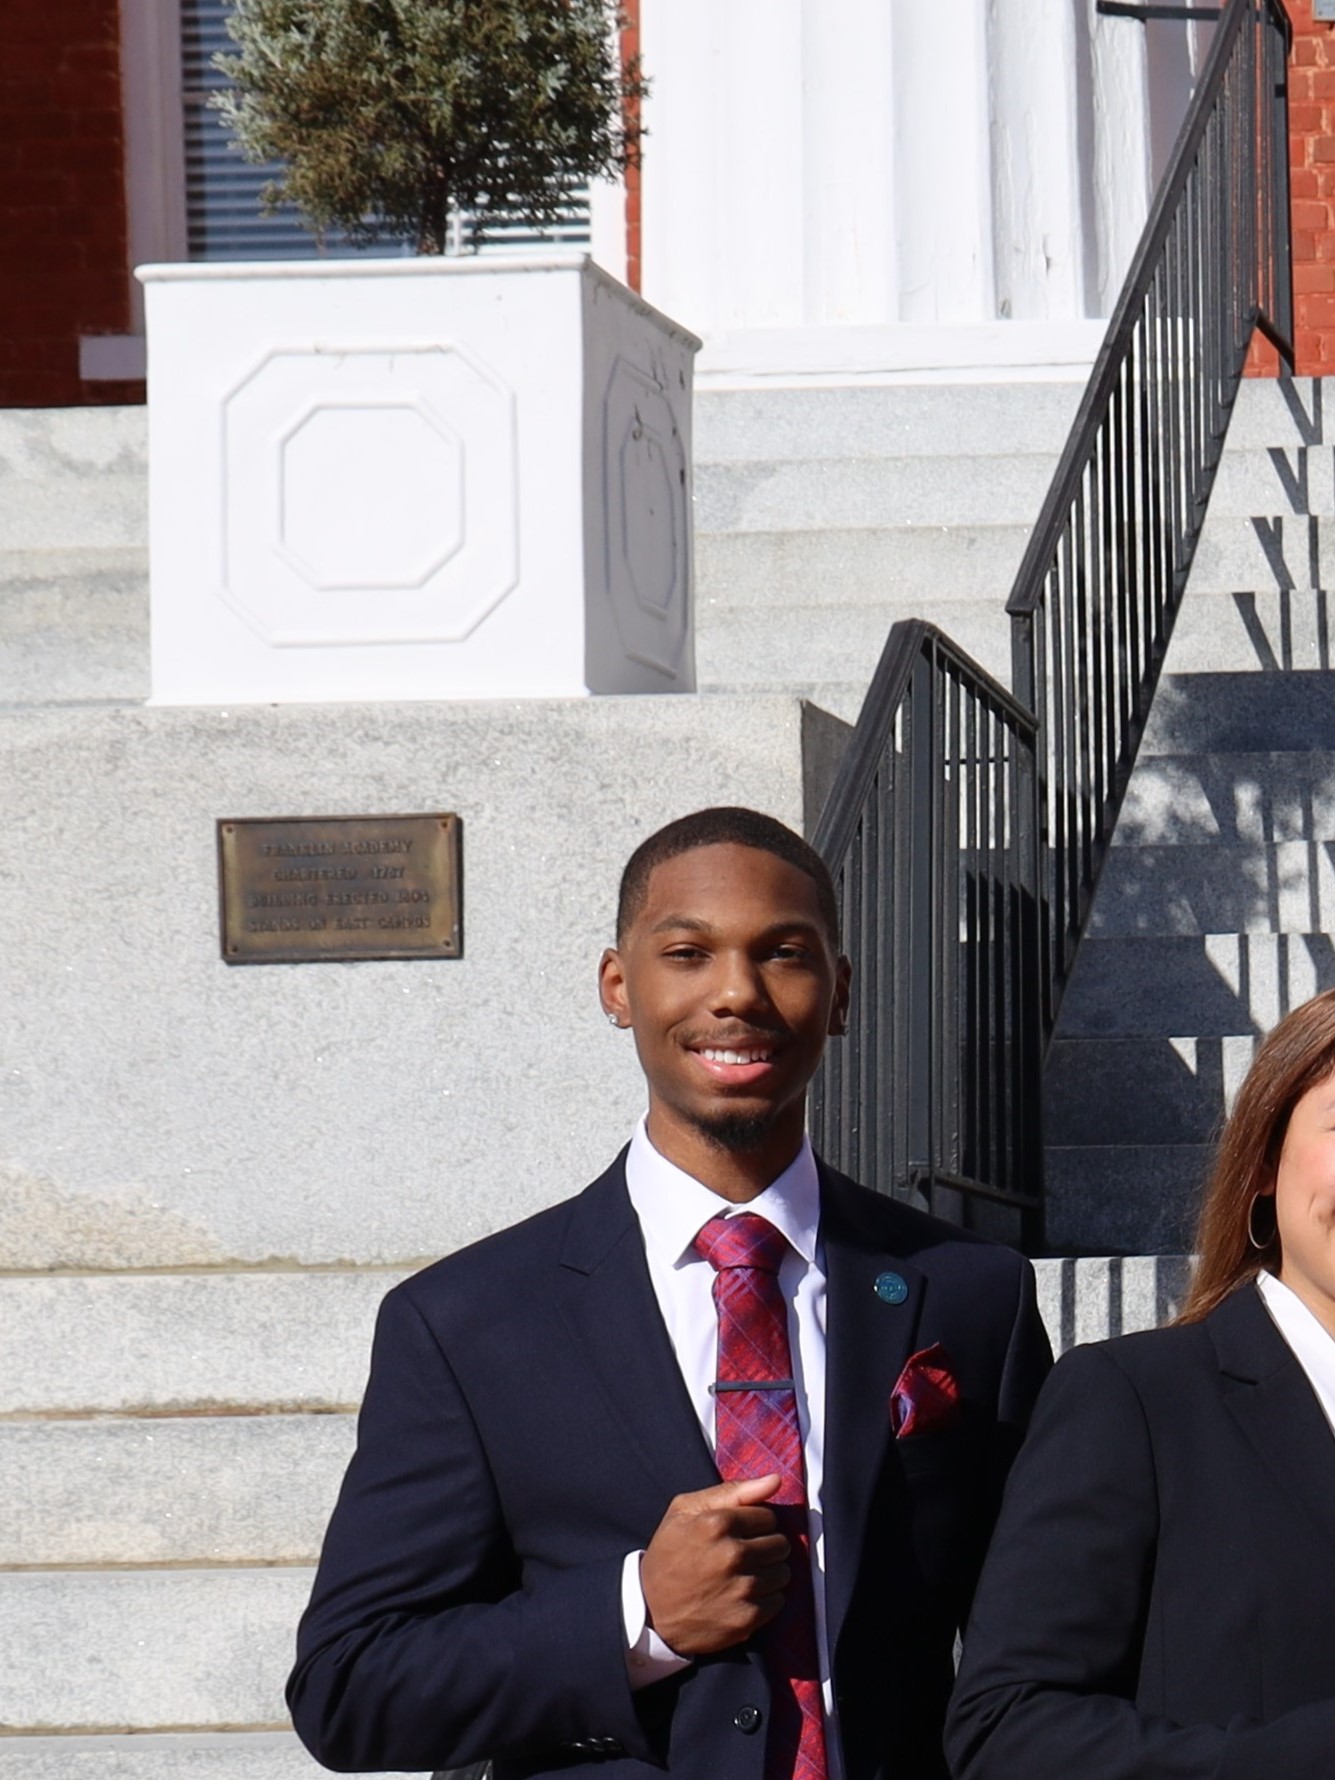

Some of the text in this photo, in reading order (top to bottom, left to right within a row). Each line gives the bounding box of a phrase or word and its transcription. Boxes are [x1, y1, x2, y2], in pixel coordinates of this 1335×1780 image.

[262, 839, 413, 857] FRANKLIN ACADEMY
[274, 867, 357, 882] CHARTERED
[326, 891, 389, 906] ERECTED
